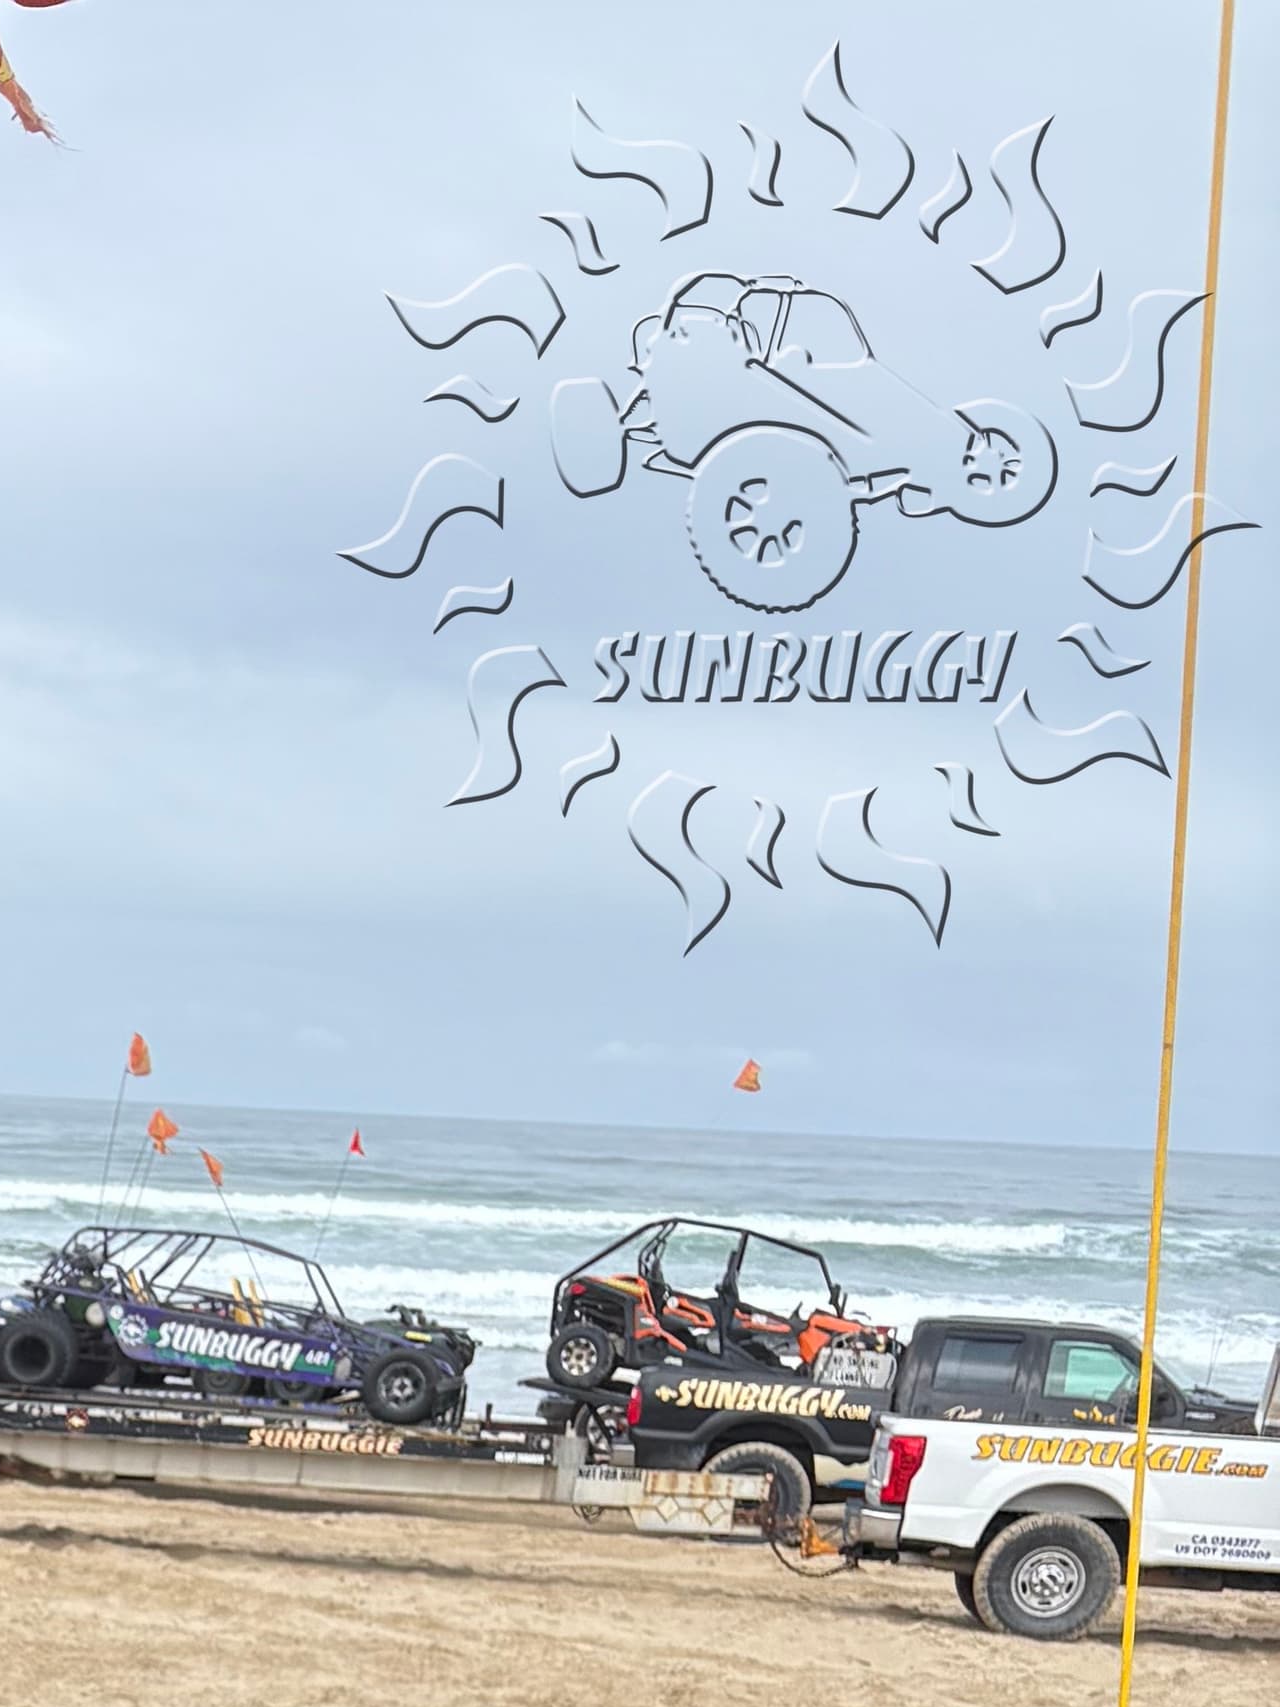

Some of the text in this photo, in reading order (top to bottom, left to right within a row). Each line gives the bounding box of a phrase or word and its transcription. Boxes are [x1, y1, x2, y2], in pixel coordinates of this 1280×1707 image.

[155, 1321, 303, 1371] SUNBUGGY
[247, 1426, 404, 1456] SUNBUGGIE
[1175, 1544, 1190, 1554] US
[1193, 1546, 1218, 1556] DOT
[1191, 1534, 1207, 1545] CA
